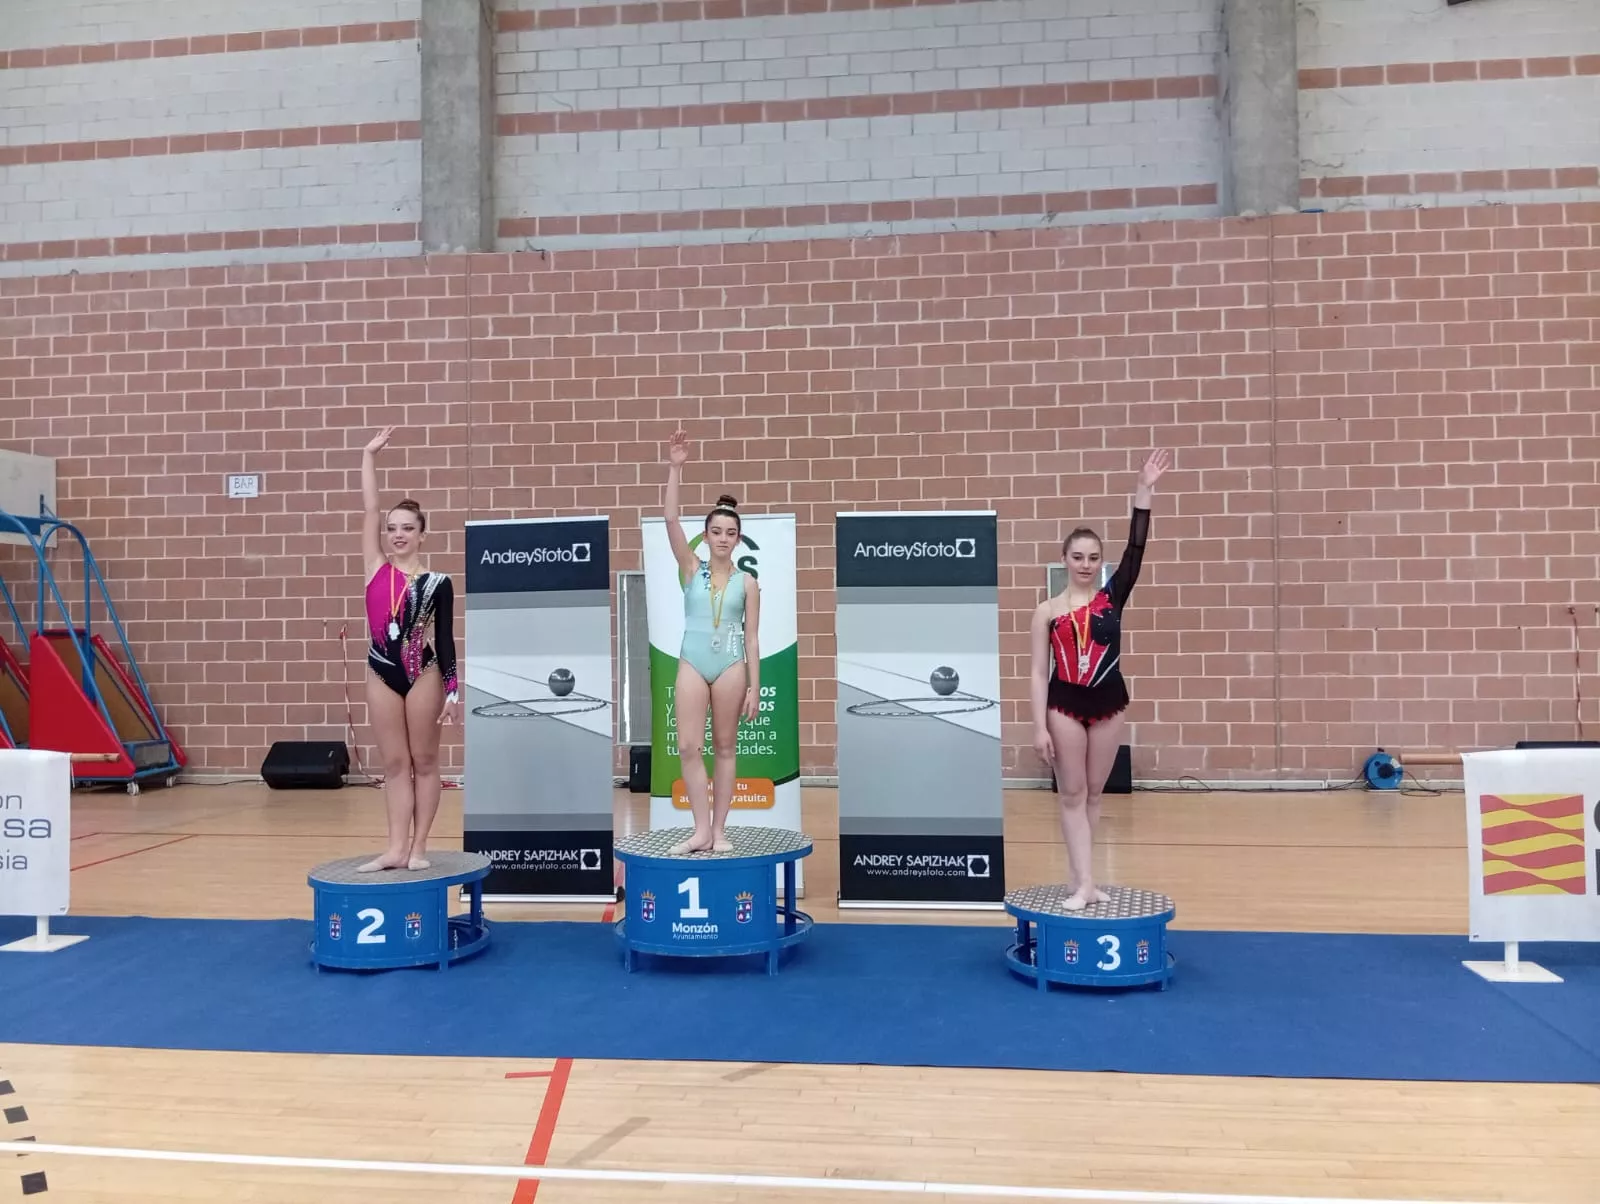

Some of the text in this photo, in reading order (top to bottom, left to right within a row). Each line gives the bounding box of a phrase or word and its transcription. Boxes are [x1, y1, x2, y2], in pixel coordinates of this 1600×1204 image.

[234, 477, 254, 489] BAR
[481, 548, 572, 565] AndreySfoto
[854, 541, 955, 560] AndreySfoto
[746, 716, 771, 729] que
[769, 731, 777, 740] a
[524, 849, 579, 861] SAPIZHAK
[853, 854, 966, 867] ANDREY SAPIZHAK
[866, 867, 966, 878] www.andreysfoto.com
[678, 877, 709, 918] 1
[356, 908, 386, 944] 2
[672, 922, 718, 933] Monzón
[1096, 934, 1121, 971] 3
